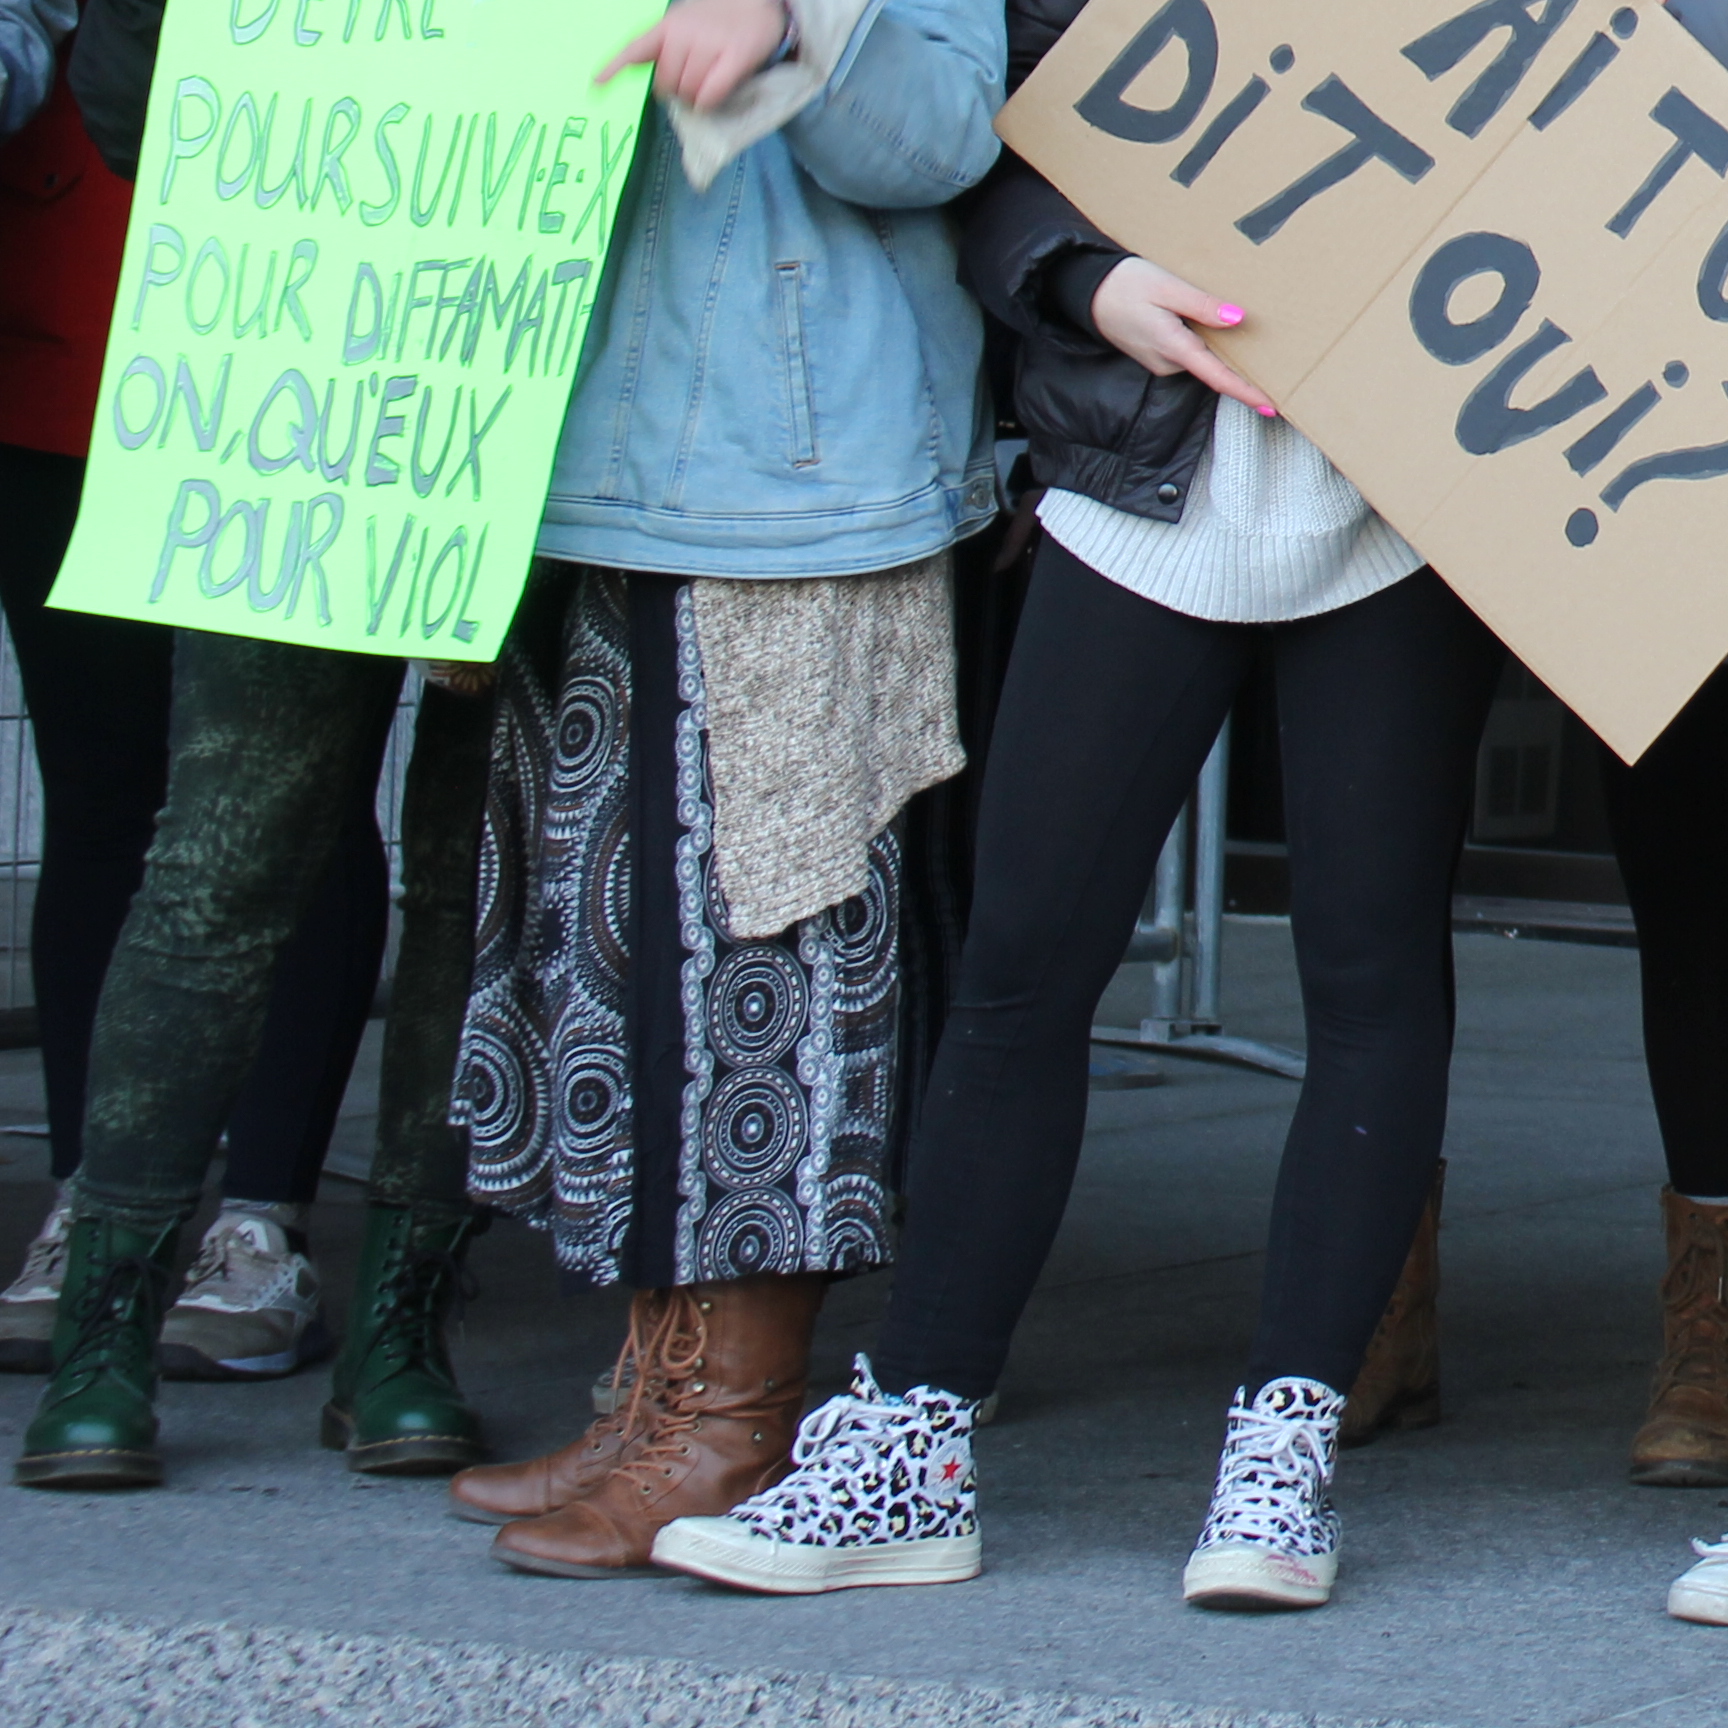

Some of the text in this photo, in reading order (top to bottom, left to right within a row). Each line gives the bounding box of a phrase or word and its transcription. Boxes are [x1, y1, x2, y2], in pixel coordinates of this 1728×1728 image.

[132, 221, 318, 342] POUR
[147, 478, 491, 644] POUR VIOL
